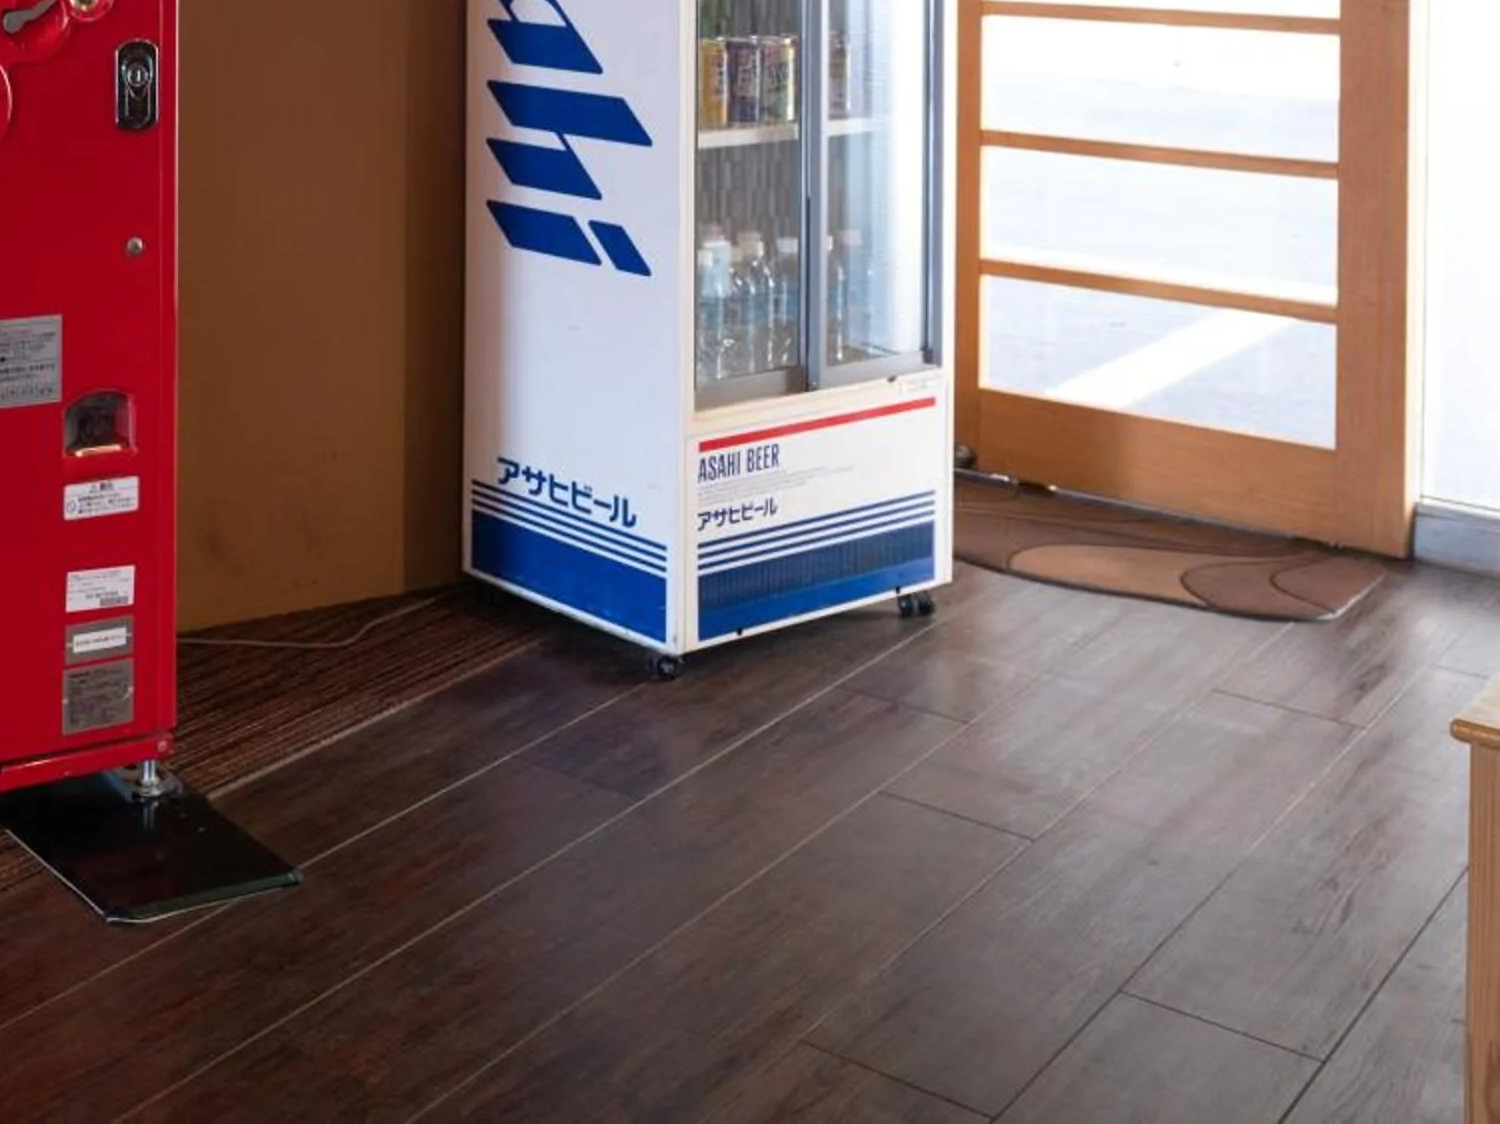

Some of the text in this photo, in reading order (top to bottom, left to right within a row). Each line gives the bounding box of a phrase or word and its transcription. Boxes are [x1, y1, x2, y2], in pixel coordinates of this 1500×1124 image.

[698, 443, 781, 483] ASAHI BEER
[497, 457, 637, 527] アサヒビール
[697, 497, 778, 531] アサヒビール
